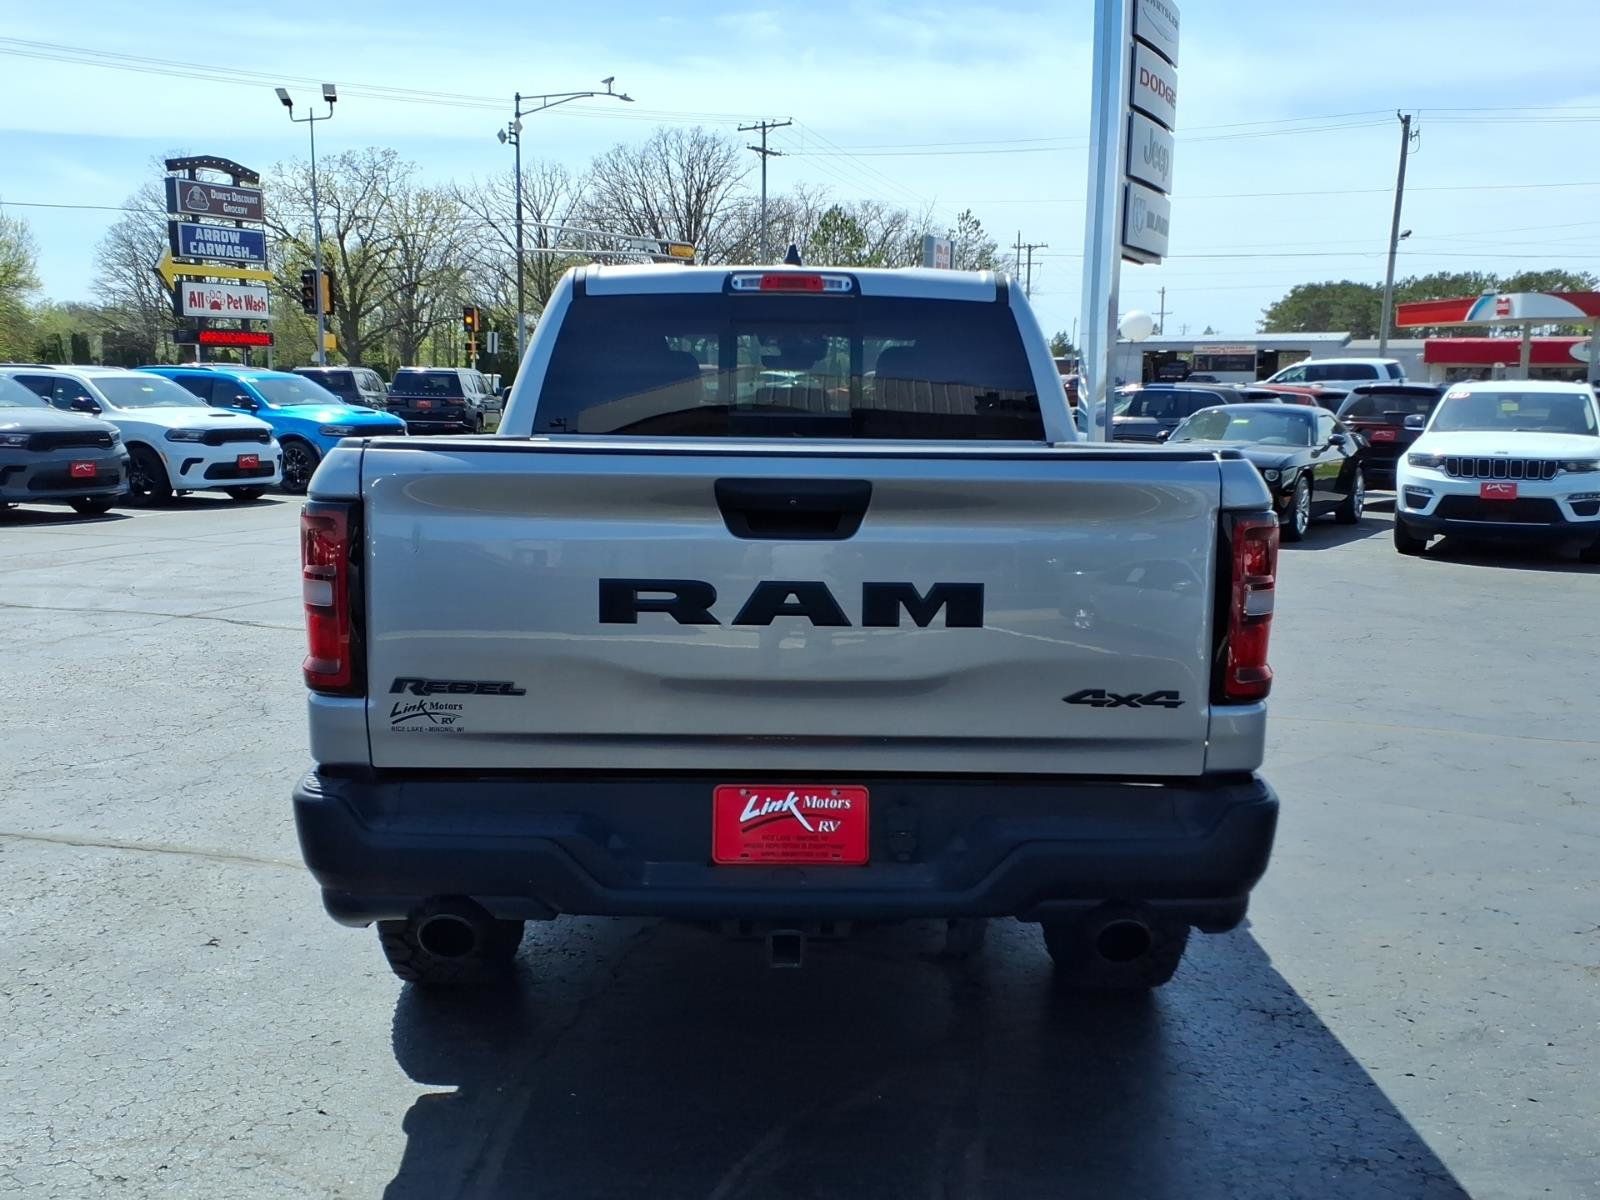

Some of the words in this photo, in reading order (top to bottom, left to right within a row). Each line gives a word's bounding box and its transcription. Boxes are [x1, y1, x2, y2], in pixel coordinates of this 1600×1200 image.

[1139, 67, 1176, 109] DODGE
[1144, 127, 1169, 181] Jeep
[195, 227, 240, 243] ARROW
[189, 291, 204, 308] All
[227, 293, 243, 310] Pet
[244, 295, 266, 312] Wash
[599, 578, 984, 627] RAM
[1062, 688, 1185, 708] 4x4
[390, 699, 438, 723] Link
[429, 701, 463, 711] Motors
[441, 717, 456, 725] RV
[740, 791, 814, 832] Link
[802, 795, 852, 809] Motors
[818, 820, 841, 832] RV
